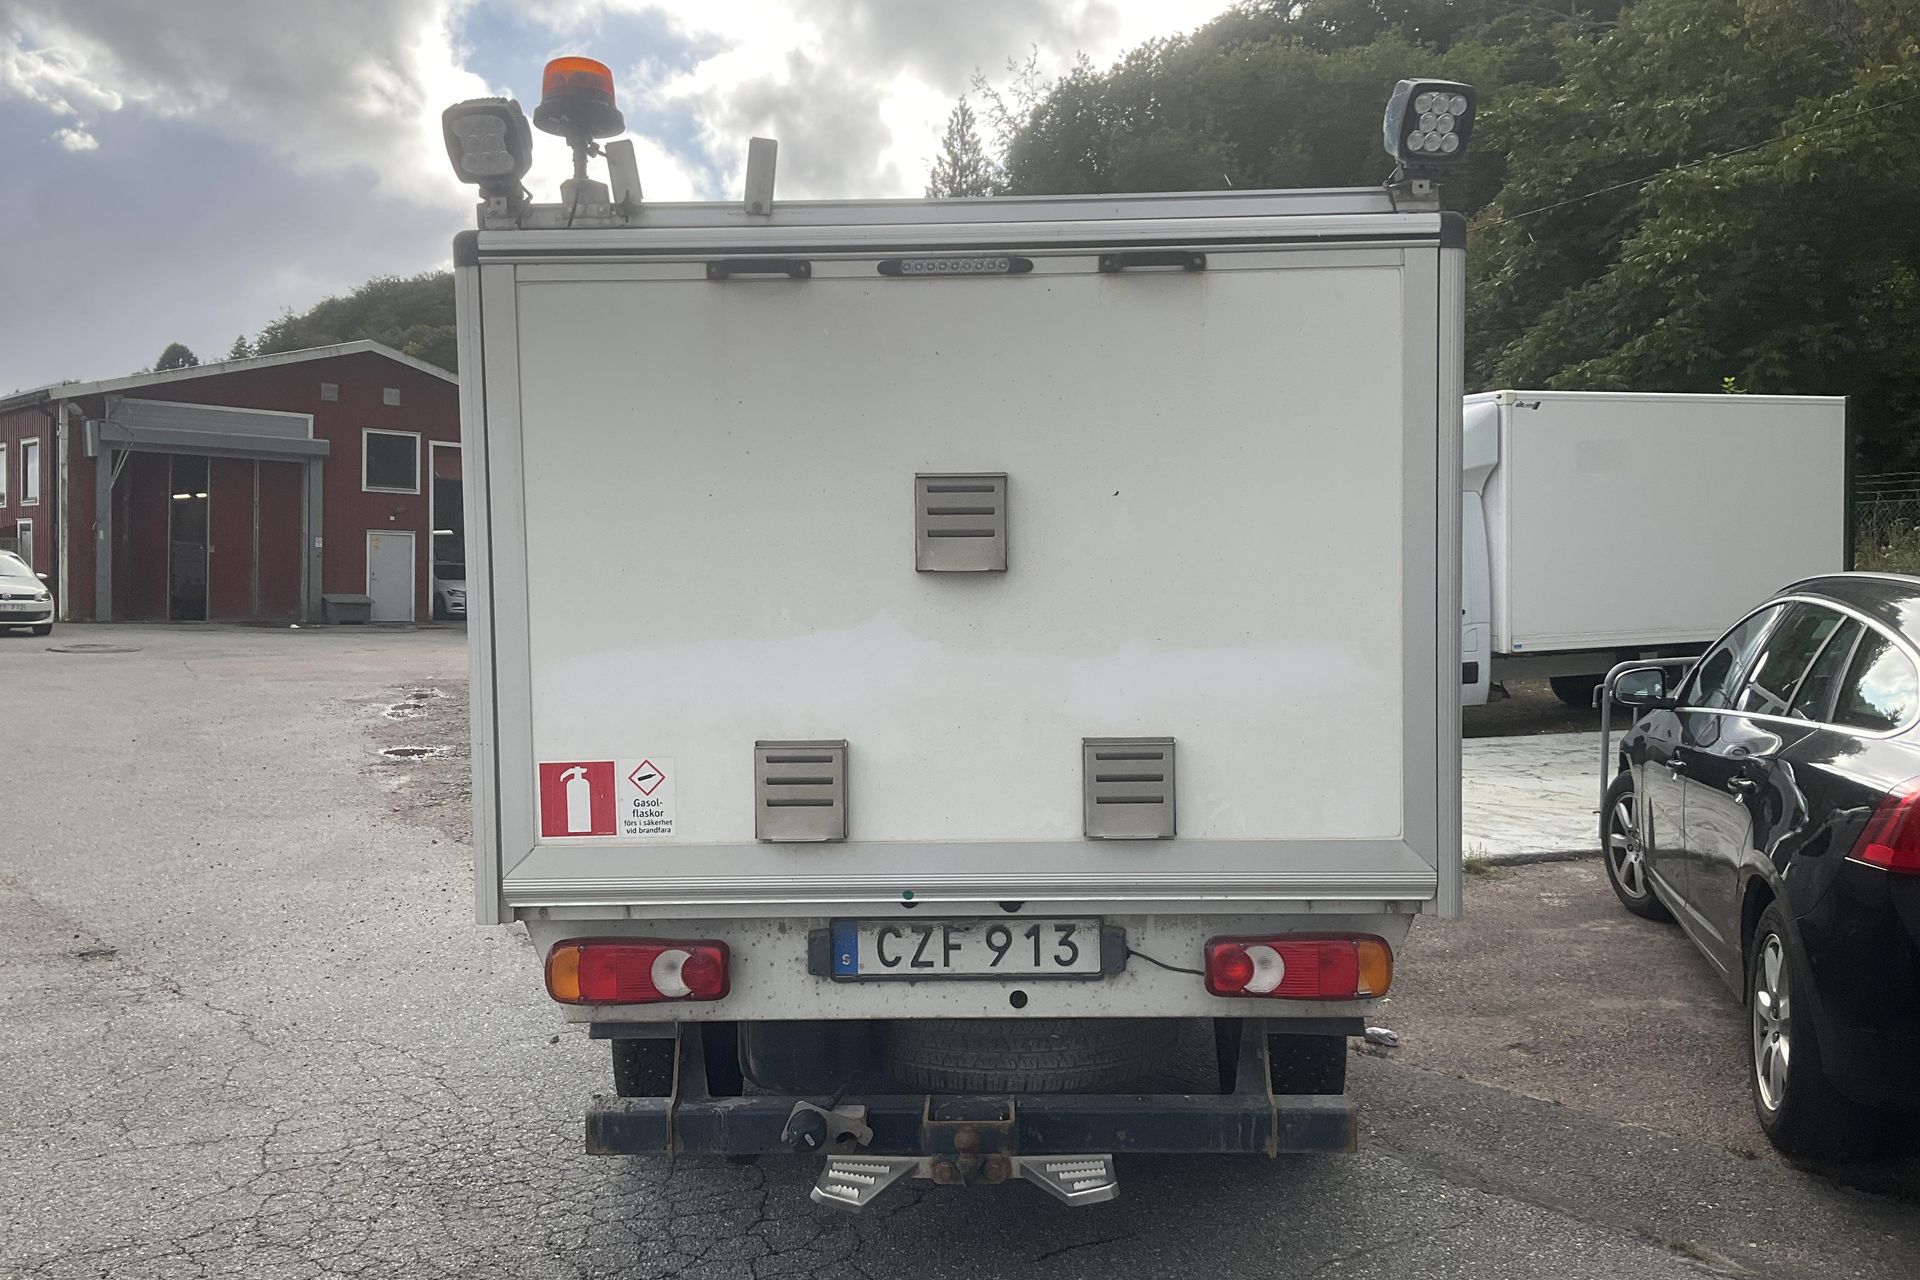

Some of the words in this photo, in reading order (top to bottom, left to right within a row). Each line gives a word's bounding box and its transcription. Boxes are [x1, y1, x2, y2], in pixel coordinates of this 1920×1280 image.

[633, 798, 663, 807] Gasol-
[632, 809, 664, 818] flaskor
[877, 924, 965, 968] CZF
[985, 923, 1079, 967] 913
[842, 954, 850, 965] S
